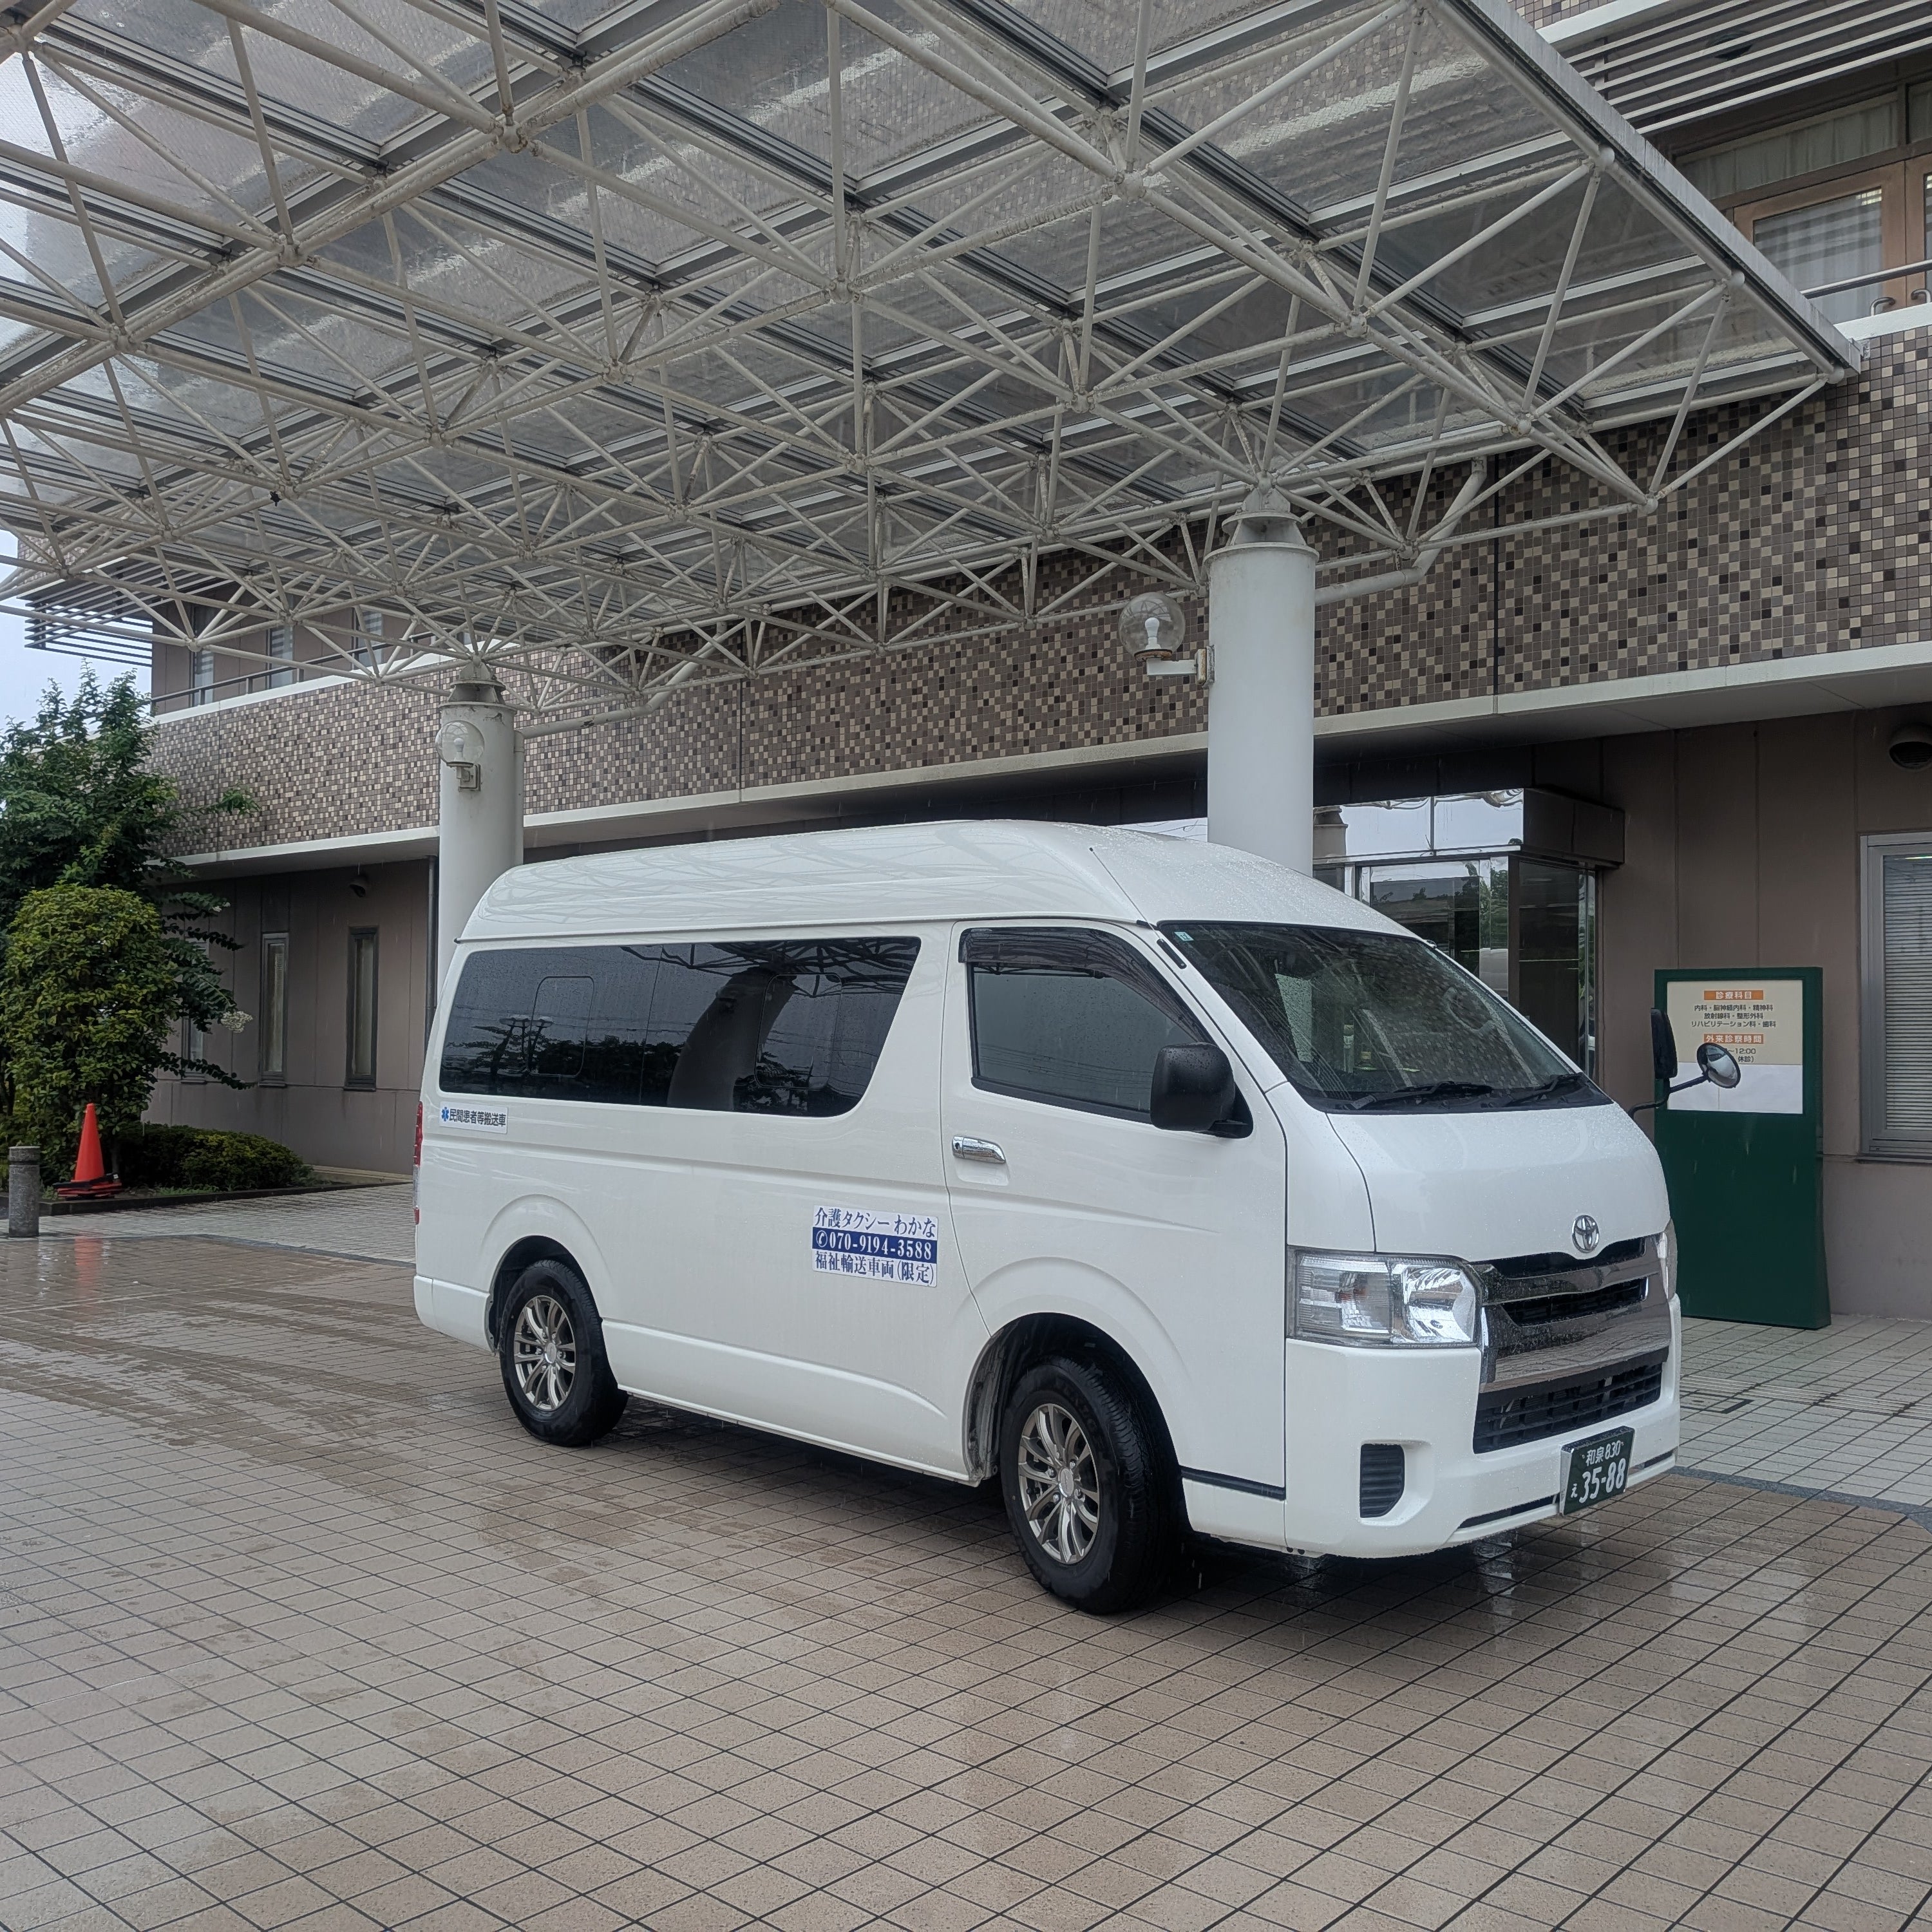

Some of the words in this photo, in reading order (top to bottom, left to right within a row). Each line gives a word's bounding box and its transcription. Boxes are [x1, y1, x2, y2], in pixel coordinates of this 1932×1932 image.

[1716, 991, 1752, 999] 診療科目
[1706, 1034, 1761, 1043] 外来診察時間
[450, 1108, 506, 1127] 民間患者等搬送車
[829, 1232, 931, 1260] 070-9194-3588
[1579, 1458, 1625, 1503] 35-88
